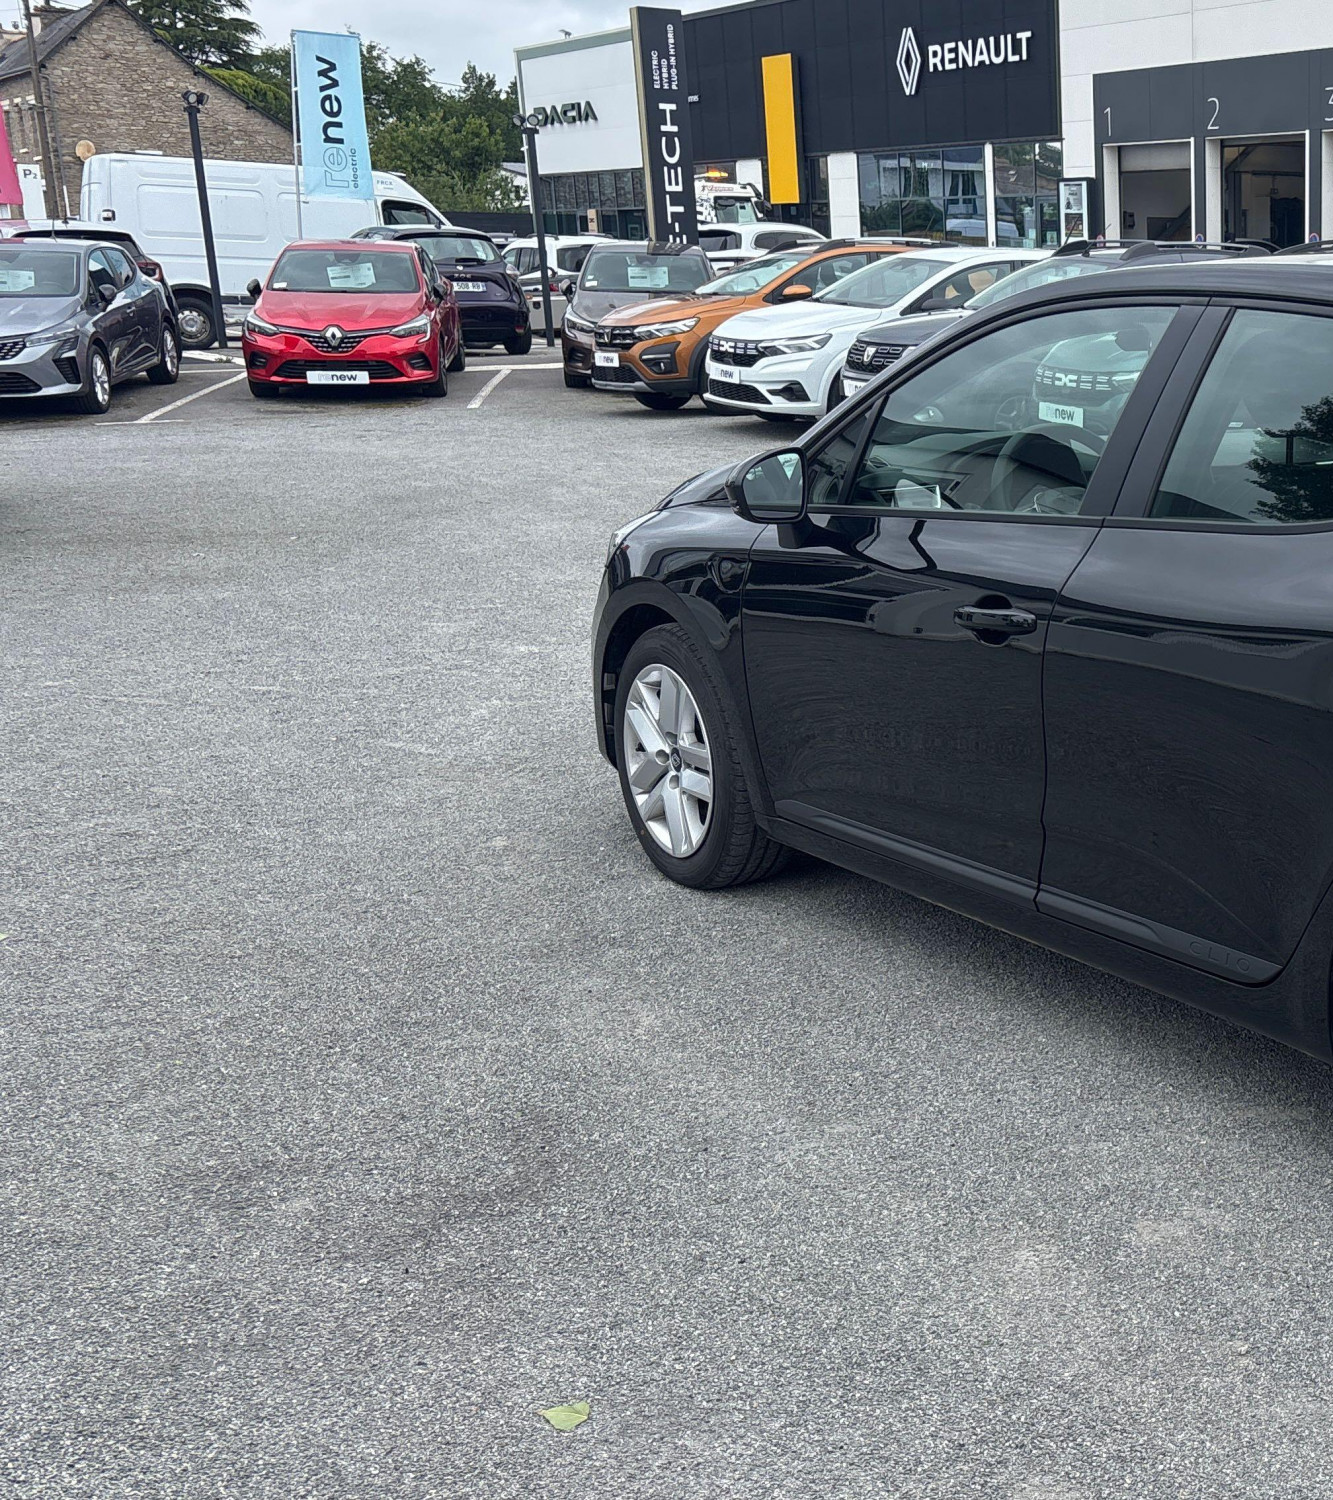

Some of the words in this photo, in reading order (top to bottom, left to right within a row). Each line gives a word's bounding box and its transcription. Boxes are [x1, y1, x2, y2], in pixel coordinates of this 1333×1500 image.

[667, 23, 675, 55] HYBRID
[928, 31, 1032, 72] RENAULT
[651, 50, 660, 89] ELECTRIC
[661, 58, 670, 89] HYBRID
[670, 56, 678, 90] PLUG-IN
[315, 54, 350, 189] renew
[533, 100, 598, 127] DACIA
[1103, 106, 1112, 136] 1
[1207, 97, 1220, 130] 2
[349, 148, 359, 189] electric
